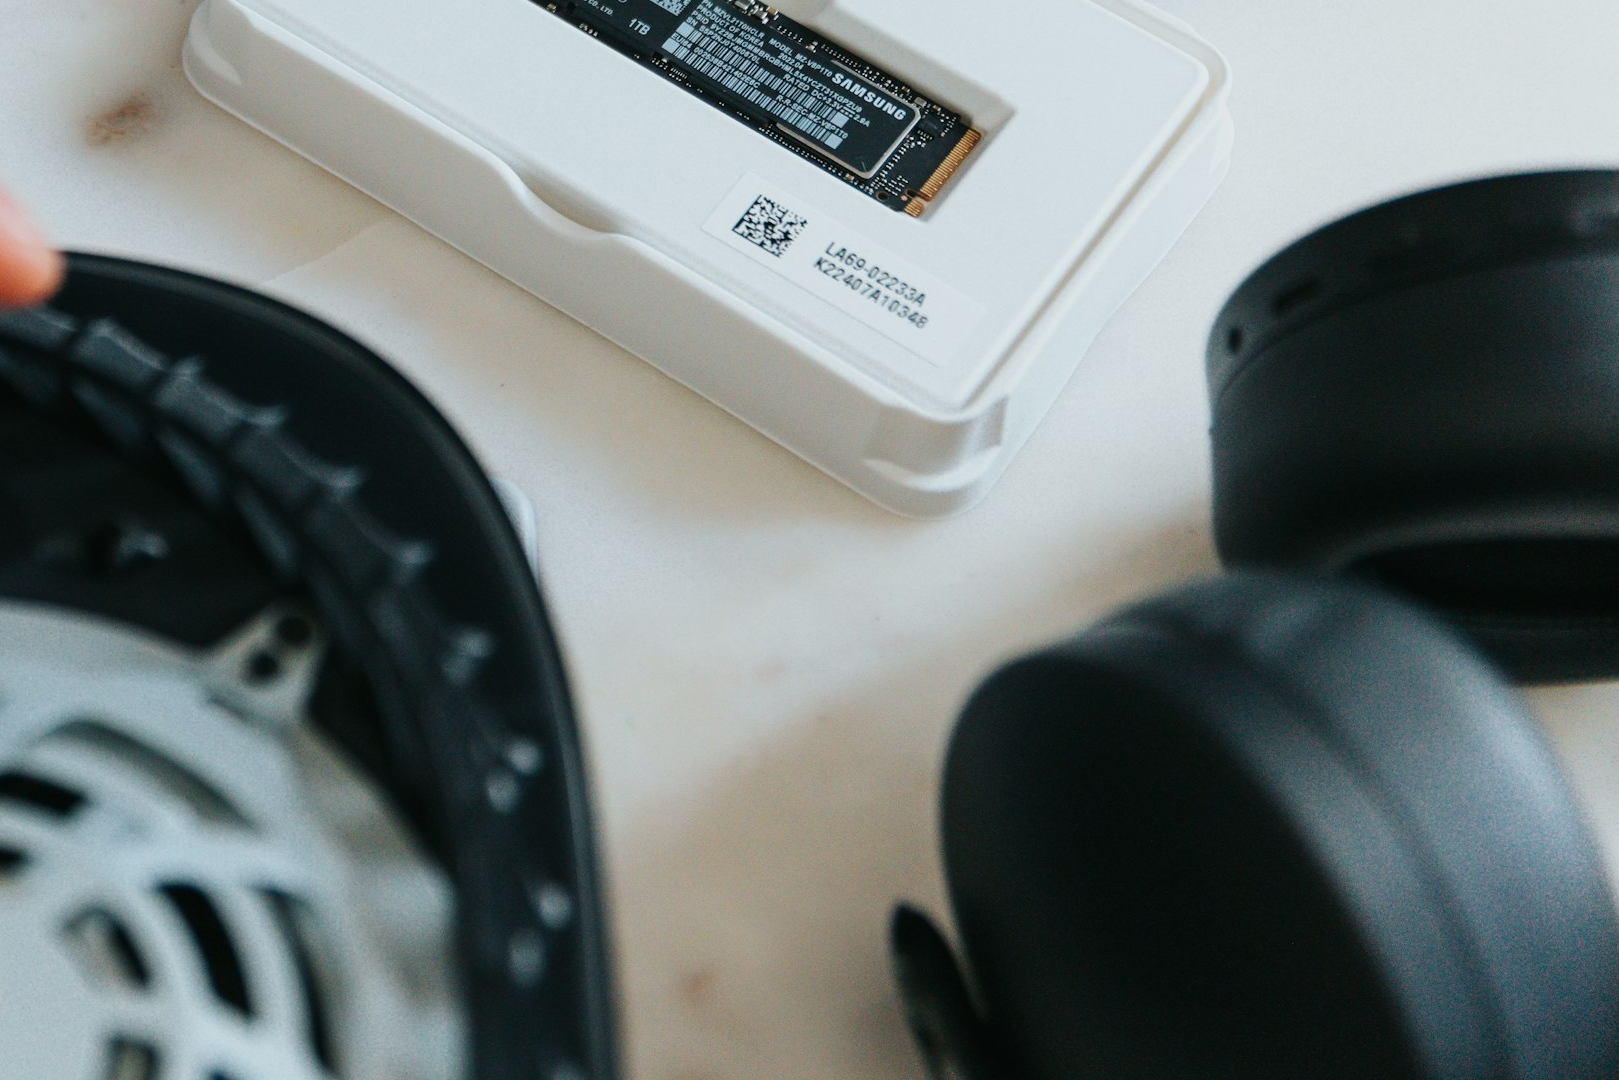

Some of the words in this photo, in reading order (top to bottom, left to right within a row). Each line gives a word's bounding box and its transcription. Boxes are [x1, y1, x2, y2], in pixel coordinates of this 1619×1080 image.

[599, 5, 614, 16] LTD.
[629, 18, 651, 35] 1TB
[690, 10, 710, 25] PSID
[685, 16, 699, 27] SN
[782, 73, 810, 91] RATED
[694, 4, 732, 28] PRODUCT
[728, 25, 741, 34] OF
[738, 30, 764, 48] KOREA
[777, 52, 804, 70] 2022.04
[768, 38, 793, 56] MODEL
[832, 73, 906, 120] SAMSUNG
[813, 256, 929, 330] K22407A10348
[825, 241, 926, 308] LA69-02233A
